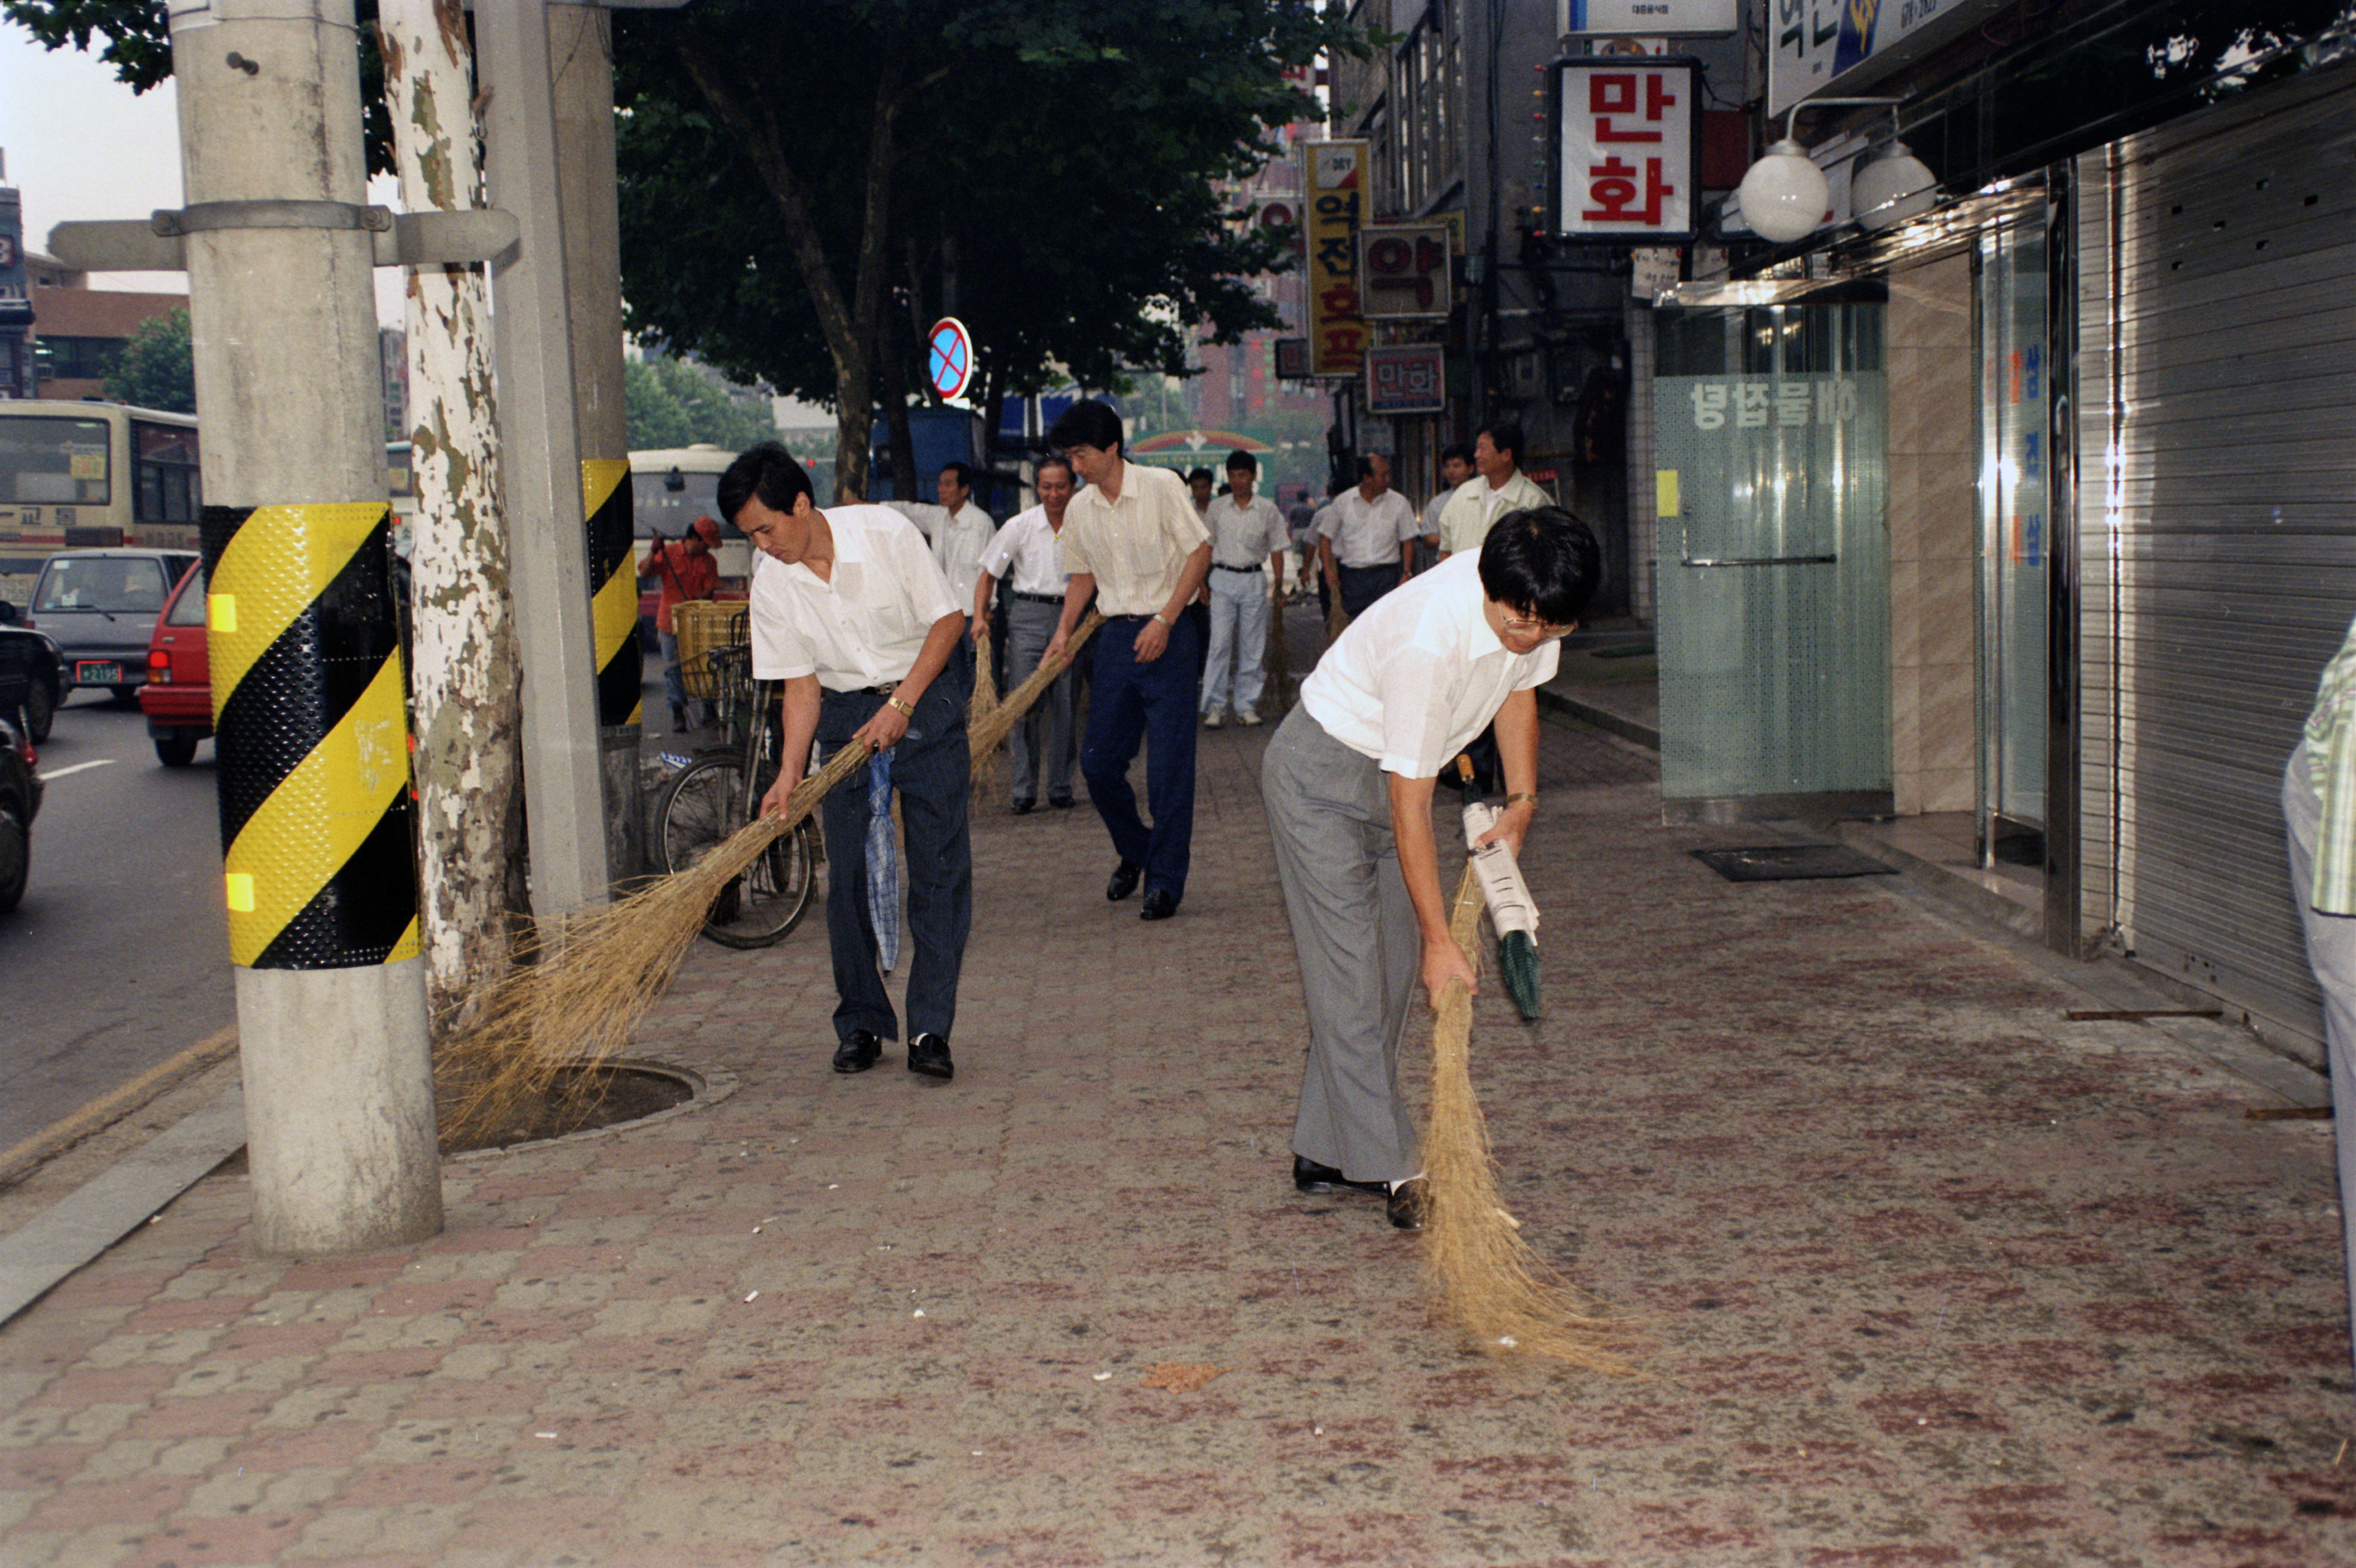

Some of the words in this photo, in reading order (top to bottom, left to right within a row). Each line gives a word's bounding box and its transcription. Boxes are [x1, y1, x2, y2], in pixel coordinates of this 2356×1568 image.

[1582, 74, 1676, 225] 만화
[1367, 235, 1444, 309] 약
[1377, 361, 1438, 397] 만화
